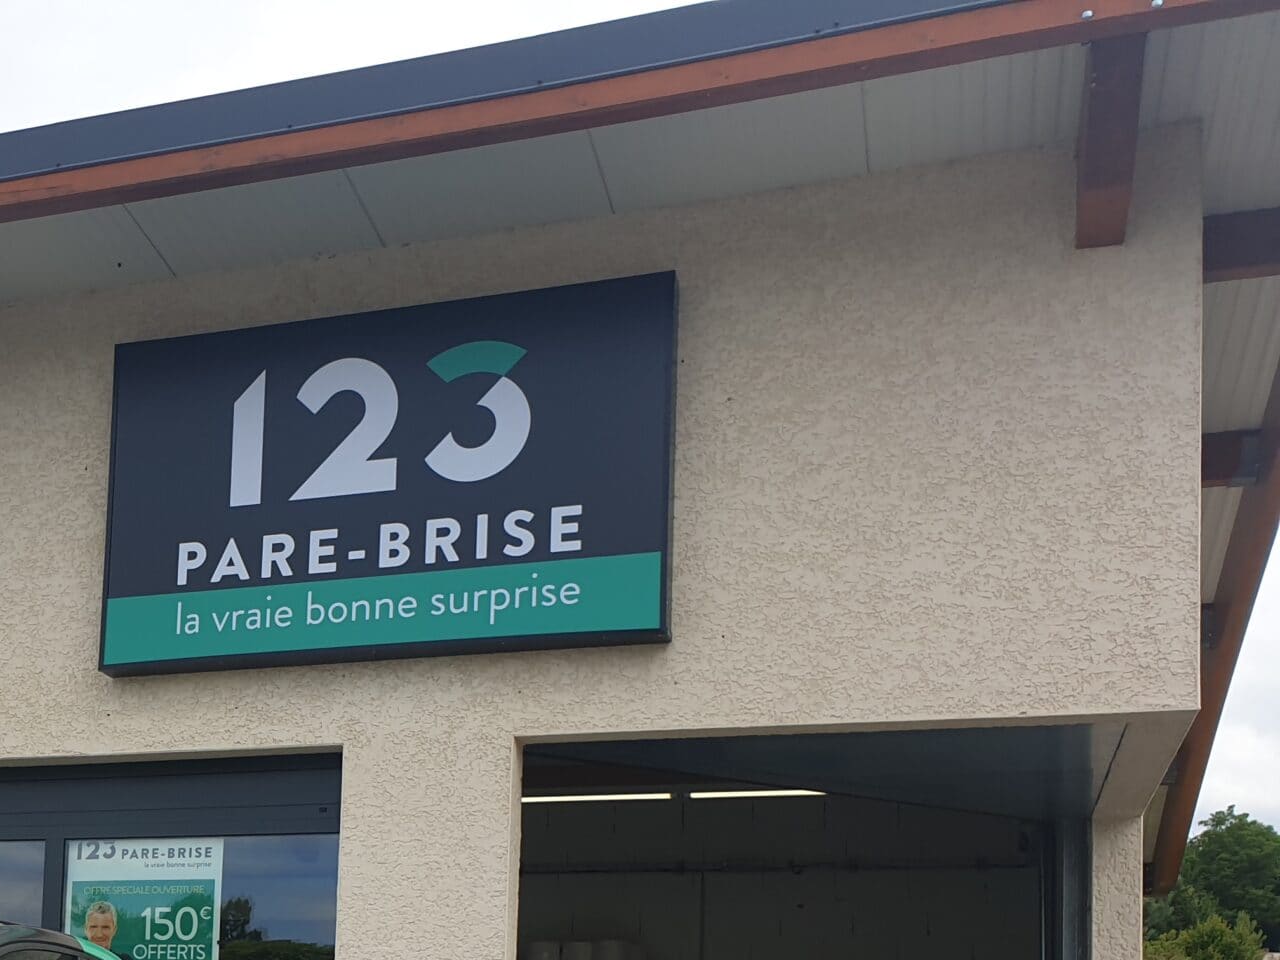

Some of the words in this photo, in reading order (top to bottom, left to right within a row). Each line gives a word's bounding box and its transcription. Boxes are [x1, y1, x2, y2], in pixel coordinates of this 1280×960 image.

[230, 340, 531, 507] 123
[176, 504, 584, 586] PARE-BRISE
[175, 602, 201, 636] la
[212, 596, 293, 632] vraie
[306, 591, 418, 626] bonne
[430, 572, 582, 625] surprise
[76, 840, 116, 860] 123
[121, 847, 213, 860] PARE-BRISE
[151, 885, 205, 894] OUVERTURE
[132, 944, 206, 960] OFFERTS
